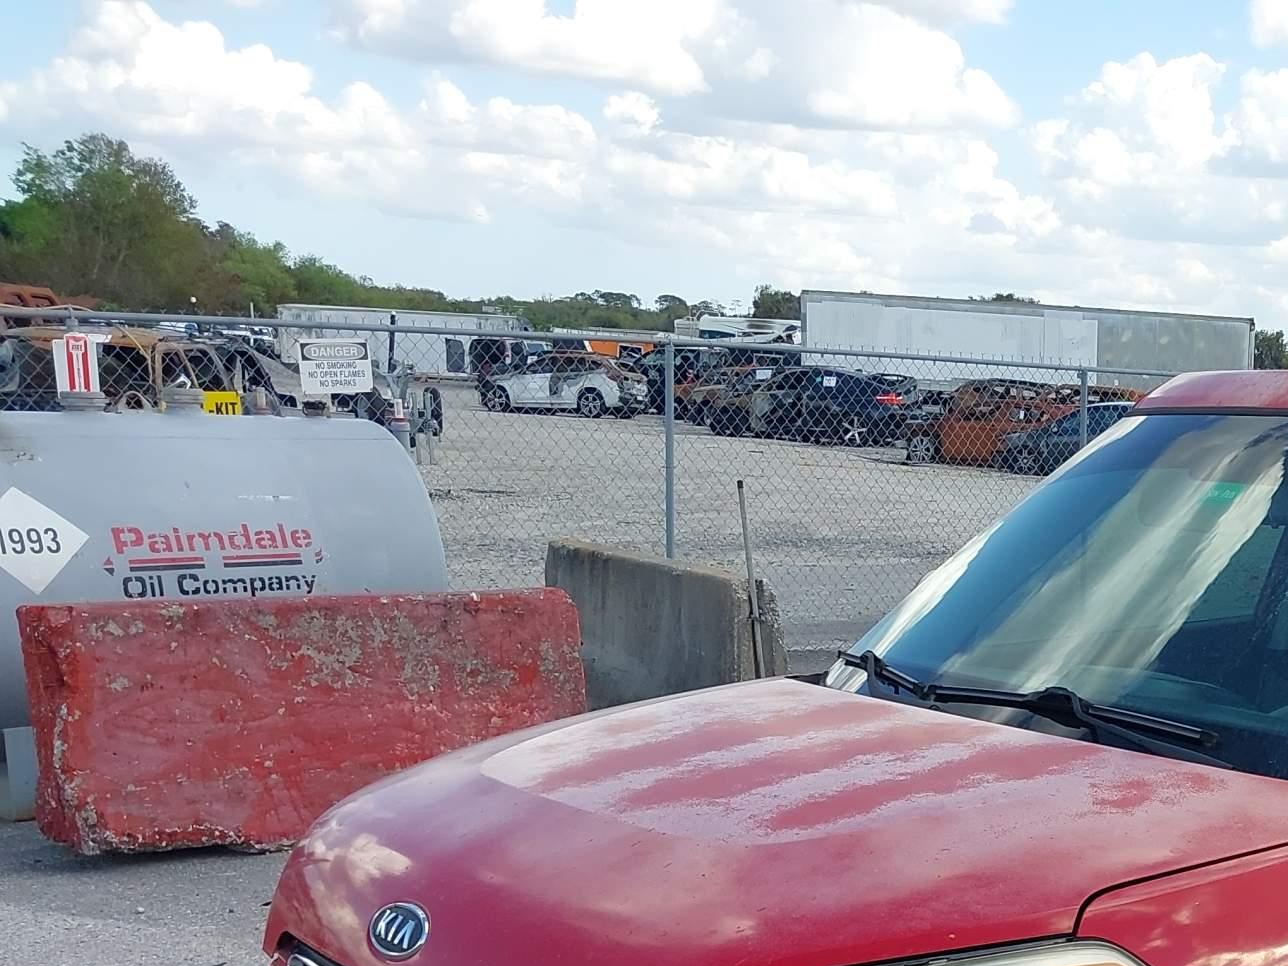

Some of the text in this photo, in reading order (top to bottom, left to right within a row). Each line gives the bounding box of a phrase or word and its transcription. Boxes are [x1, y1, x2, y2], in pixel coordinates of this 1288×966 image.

[310, 346, 358, 357] DANGER
[315, 361, 357, 370] NO SMOKING
[320, 370, 338, 378] OPEN
[340, 370, 366, 378] FLAMES
[331, 379, 357, 387] SPARKS
[0, 527, 61, 555] 1993
[122, 573, 317, 599] Oil Company
[375, 909, 415, 949] KIA
